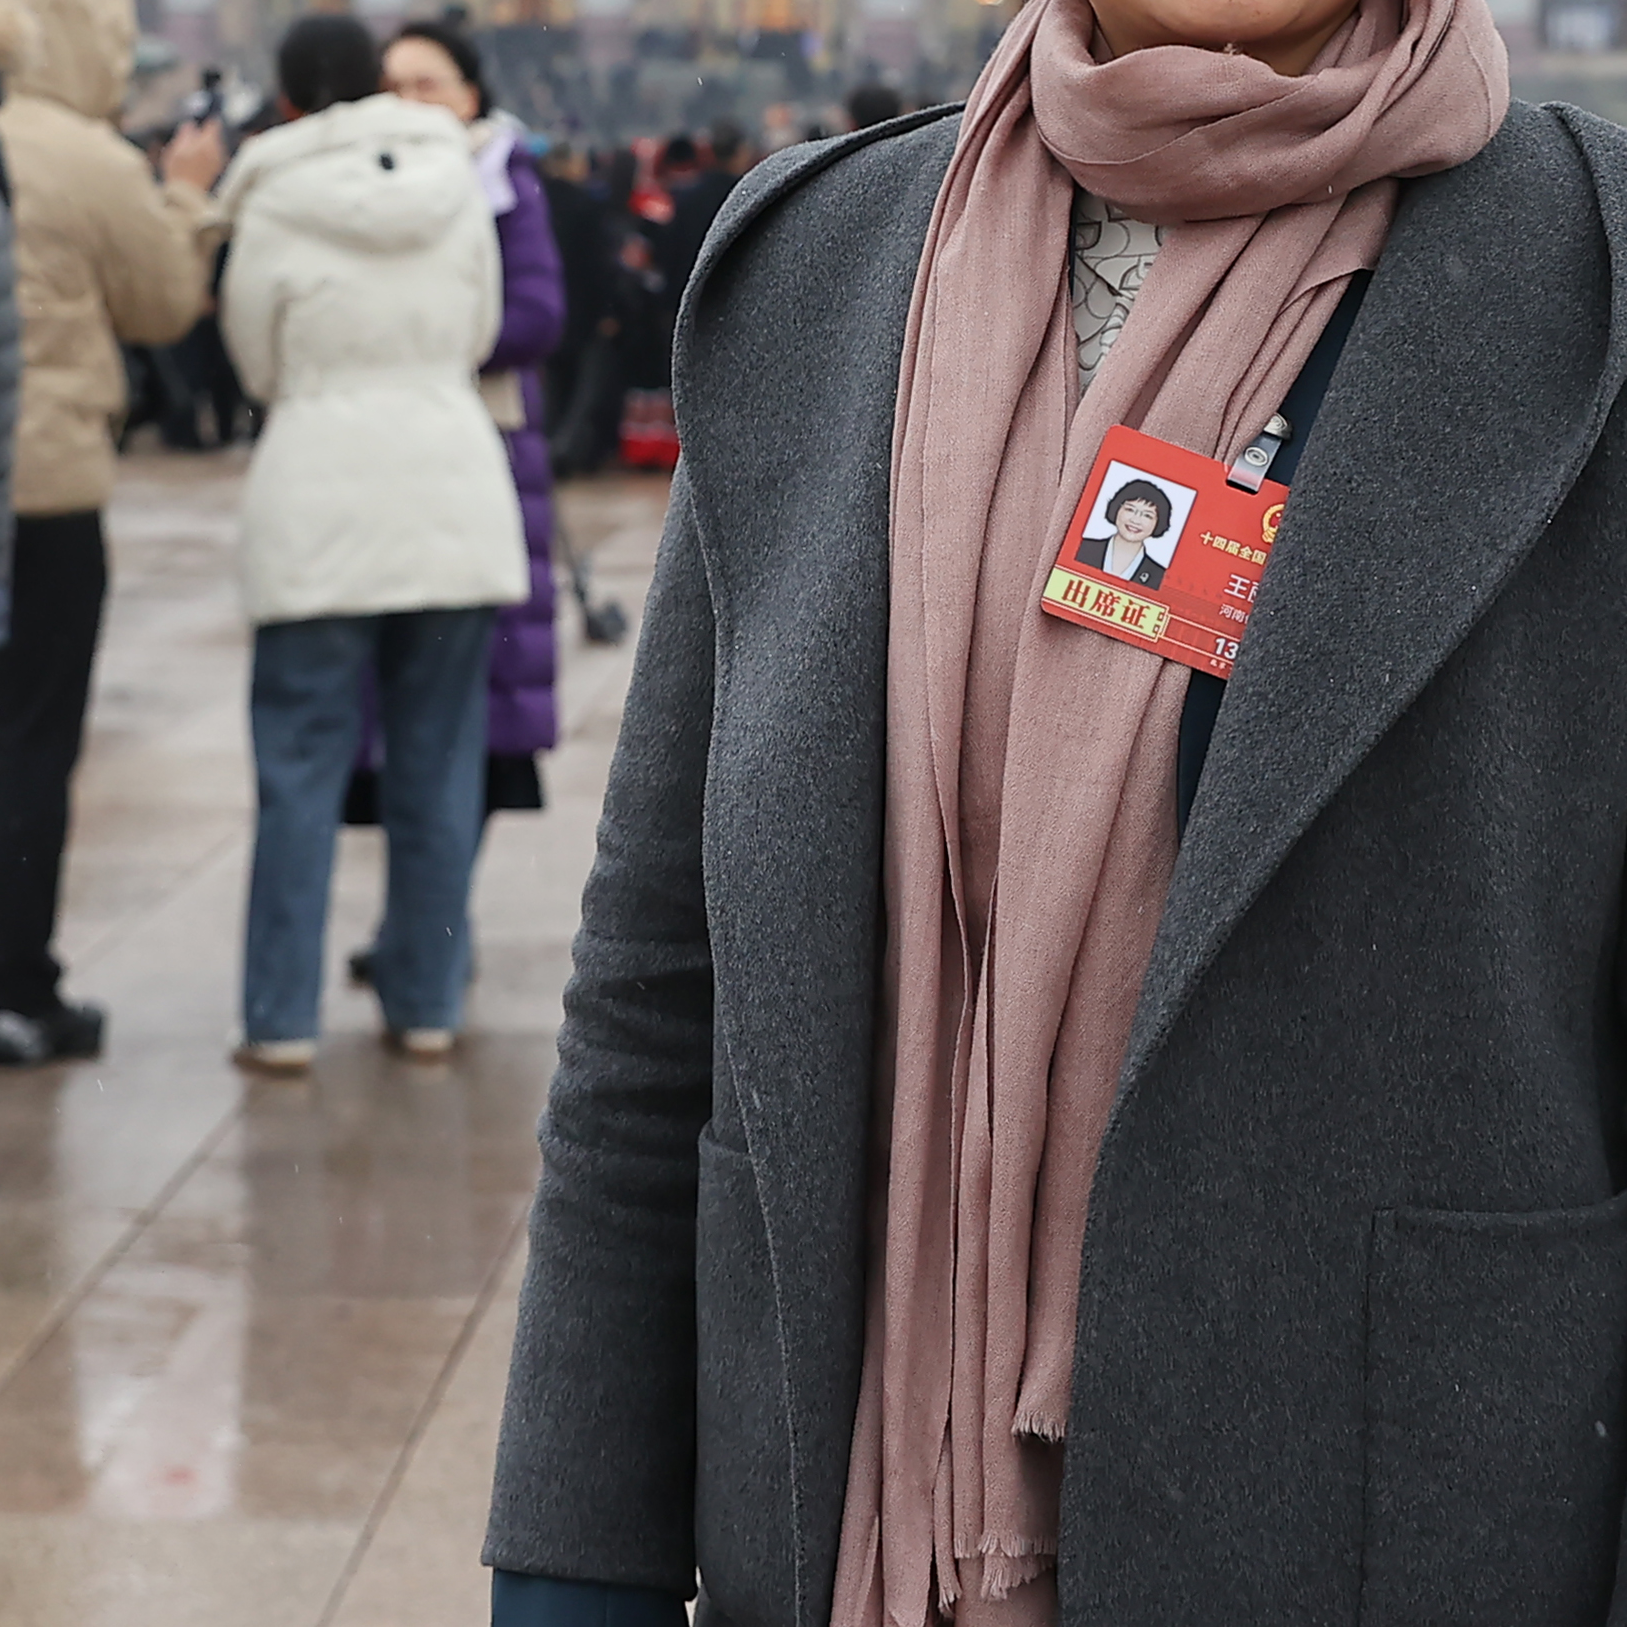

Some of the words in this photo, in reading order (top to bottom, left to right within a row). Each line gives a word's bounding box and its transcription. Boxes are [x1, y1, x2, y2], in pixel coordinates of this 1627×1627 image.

[1200, 531, 1267, 566] 十四届全国
[1061, 579, 1150, 629] 出席证
[1219, 603, 1250, 624] 河南
[1215, 638, 1239, 659] 13
